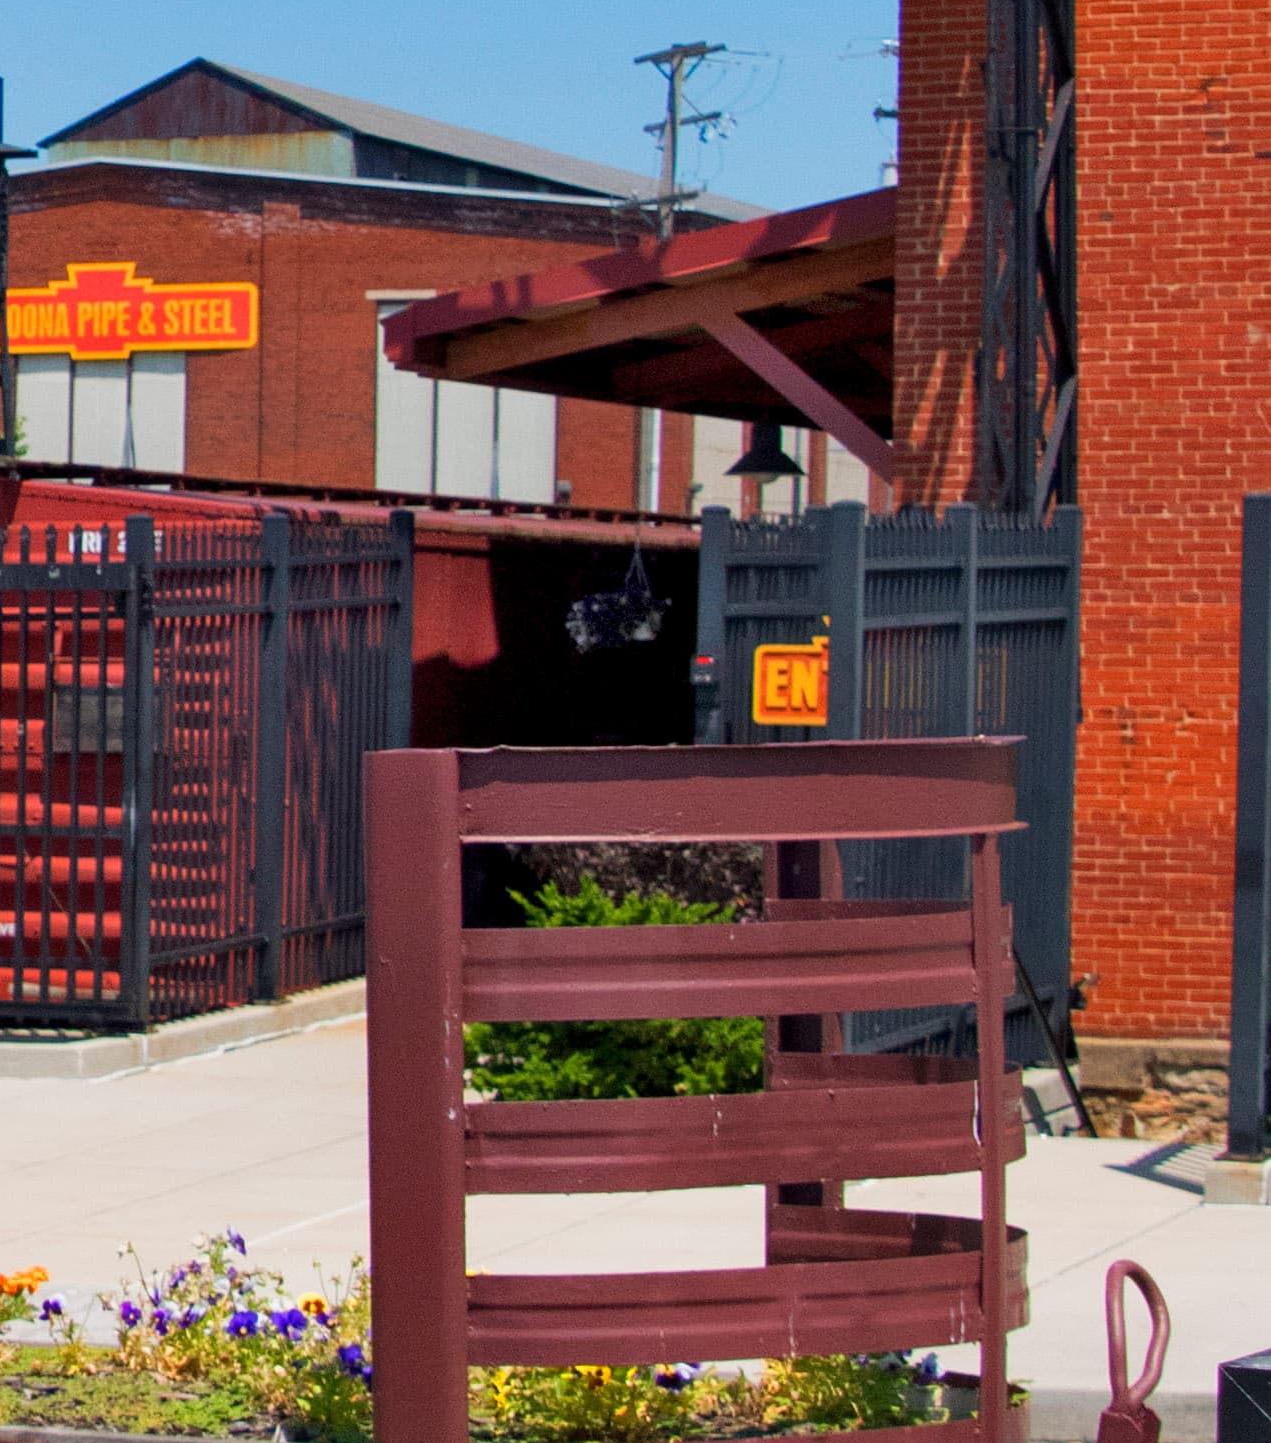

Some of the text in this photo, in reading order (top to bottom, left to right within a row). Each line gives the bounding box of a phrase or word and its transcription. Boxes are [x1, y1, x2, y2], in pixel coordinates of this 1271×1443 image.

[76, 299, 131, 338] PIPE
[137, 301, 156, 335] &
[163, 298, 237, 335] STEEL
